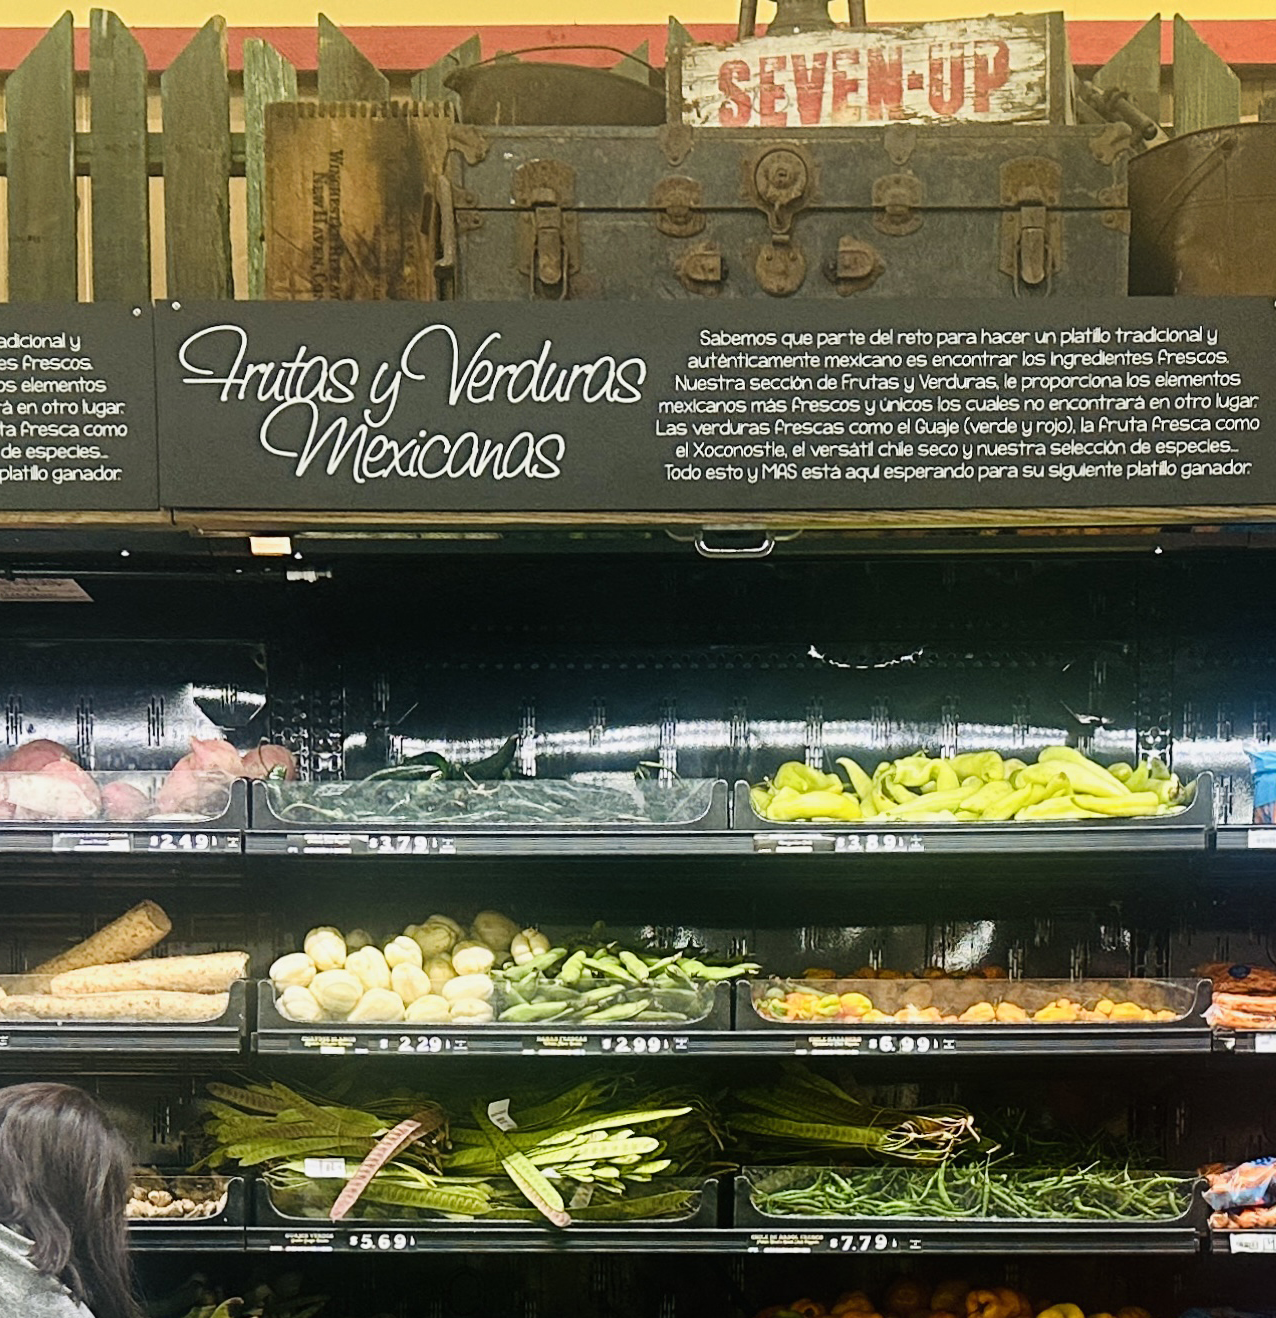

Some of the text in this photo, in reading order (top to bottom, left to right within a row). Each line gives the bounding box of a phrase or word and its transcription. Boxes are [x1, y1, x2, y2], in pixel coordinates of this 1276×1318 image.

[718, 39, 1011, 127] SEVEN-UP
[69, 335, 81, 352] y
[699, 325, 1218, 349] Sabemos que parte del reto para hacer un platillo tradicional y
[178, 323, 648, 428] Frutas y Verduras
[20, 376, 107, 393] elementos
[16, 402, 38, 415] en
[41, 398, 79, 415] otro
[20, 420, 80, 437] fresca
[82, 424, 128, 437] como
[0, 442, 22, 459] de
[259, 400, 566, 484] Mexicanas
